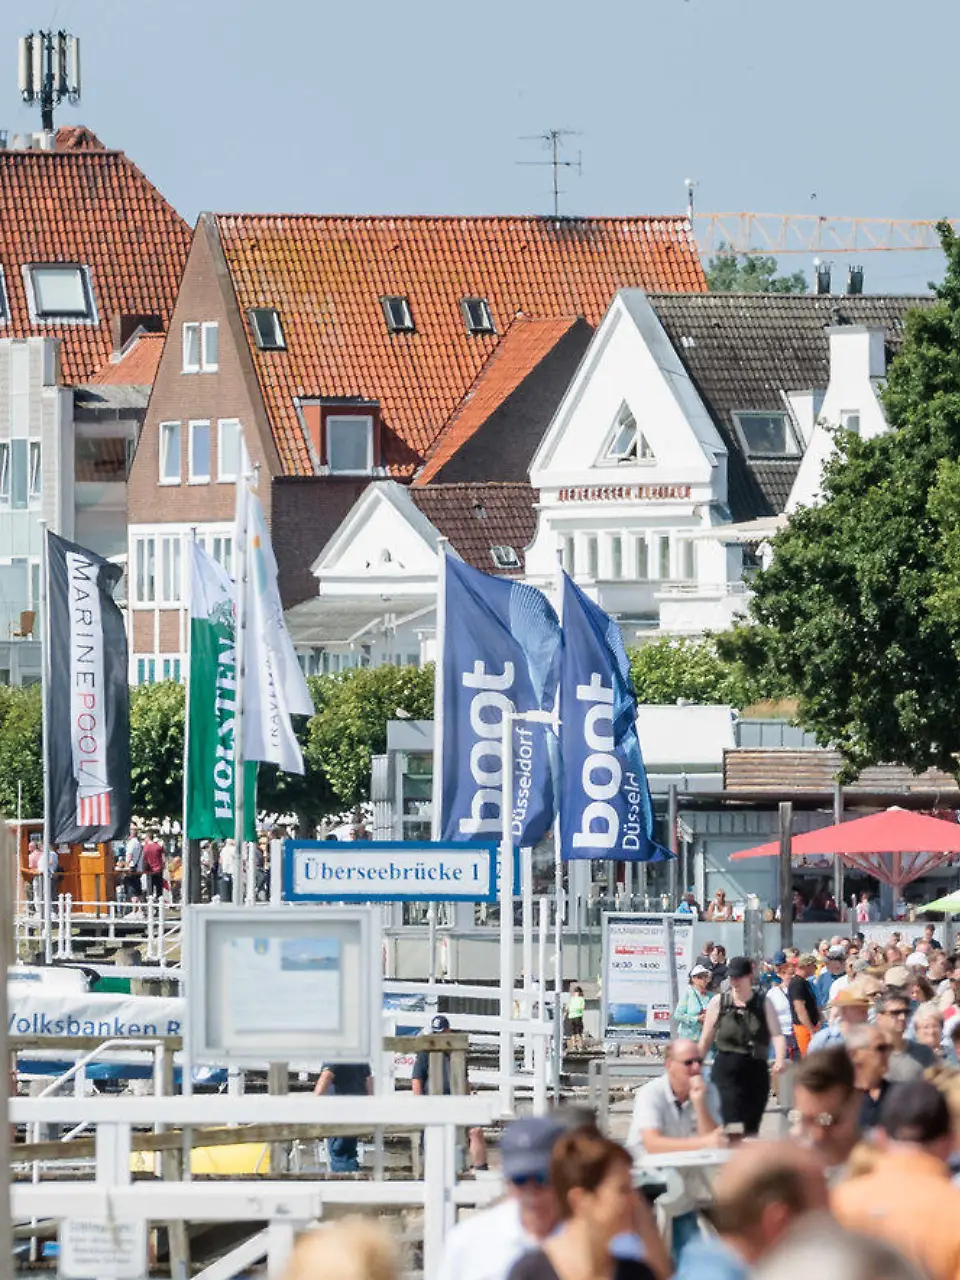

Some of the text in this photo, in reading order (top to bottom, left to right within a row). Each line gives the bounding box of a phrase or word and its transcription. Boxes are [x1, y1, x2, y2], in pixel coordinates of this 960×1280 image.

[72, 557, 100, 772] MARINEPOOL
[459, 660, 516, 834] boot
[511, 726, 534, 836] Düsseldorf
[572, 672, 622, 849] boot
[304, 857, 463, 881] Überseebrücke
[472, 862, 480, 881] 1
